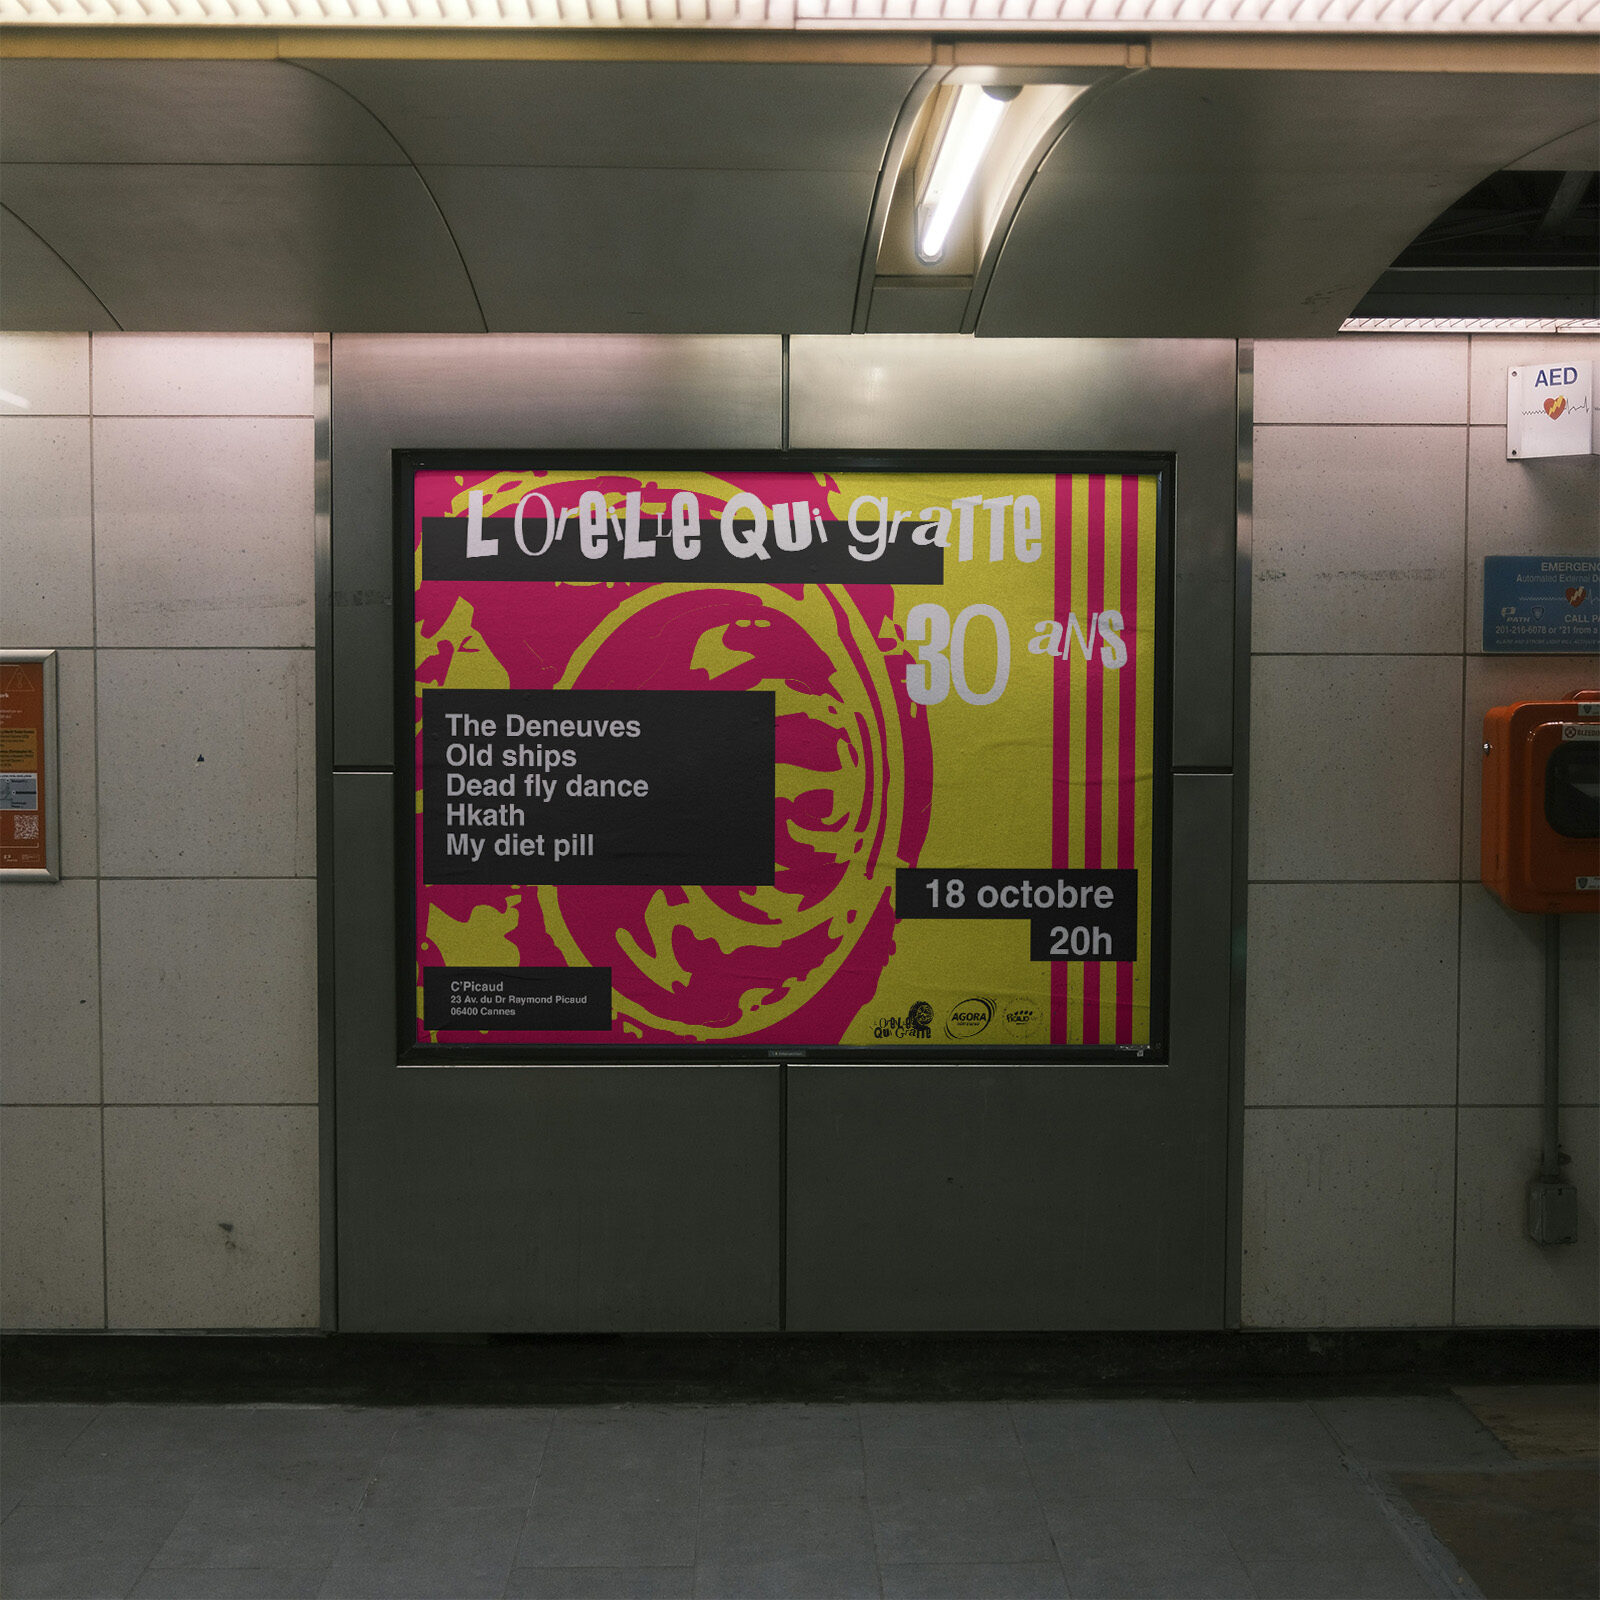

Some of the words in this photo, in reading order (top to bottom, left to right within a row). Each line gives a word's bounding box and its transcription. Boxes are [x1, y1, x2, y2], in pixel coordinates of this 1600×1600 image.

[1534, 366, 1578, 388] AED
[1516, 574, 1558, 583] Automated
[1559, 574, 1591, 583] External
[1548, 626, 1557, 634] or
[1573, 625, 1592, 634] from
[1564, 614, 1590, 623] CALL
[906, 602, 1011, 706] 30
[445, 713, 497, 738] The
[506, 713, 641, 738] Deneuves
[446, 743, 493, 768] Old
[501, 743, 578, 772] ships
[446, 773, 516, 797] Dead
[524, 773, 557, 803] fly
[565, 773, 649, 798] dance
[446, 803, 525, 827] Hkath
[446, 833, 486, 862] My
[494, 833, 545, 857] diet
[553, 833, 594, 862] pill
[926, 878, 966, 909] 18
[977, 878, 1115, 909] octobre
[1049, 925, 1113, 956] 20h
[450, 981, 504, 992] C'Picaud
[450, 995, 462, 1004] 23
[464, 995, 478, 1004] Av.
[480, 995, 493, 1004] du
[495, 995, 506, 1004] Dr
[508, 995, 553, 1006] Raymond
[555, 995, 588, 1004] Picaud
[450, 1007, 478, 1016] 06400
[480, 1007, 516, 1016] Cannes
[951, 1012, 987, 1022] AGORA
